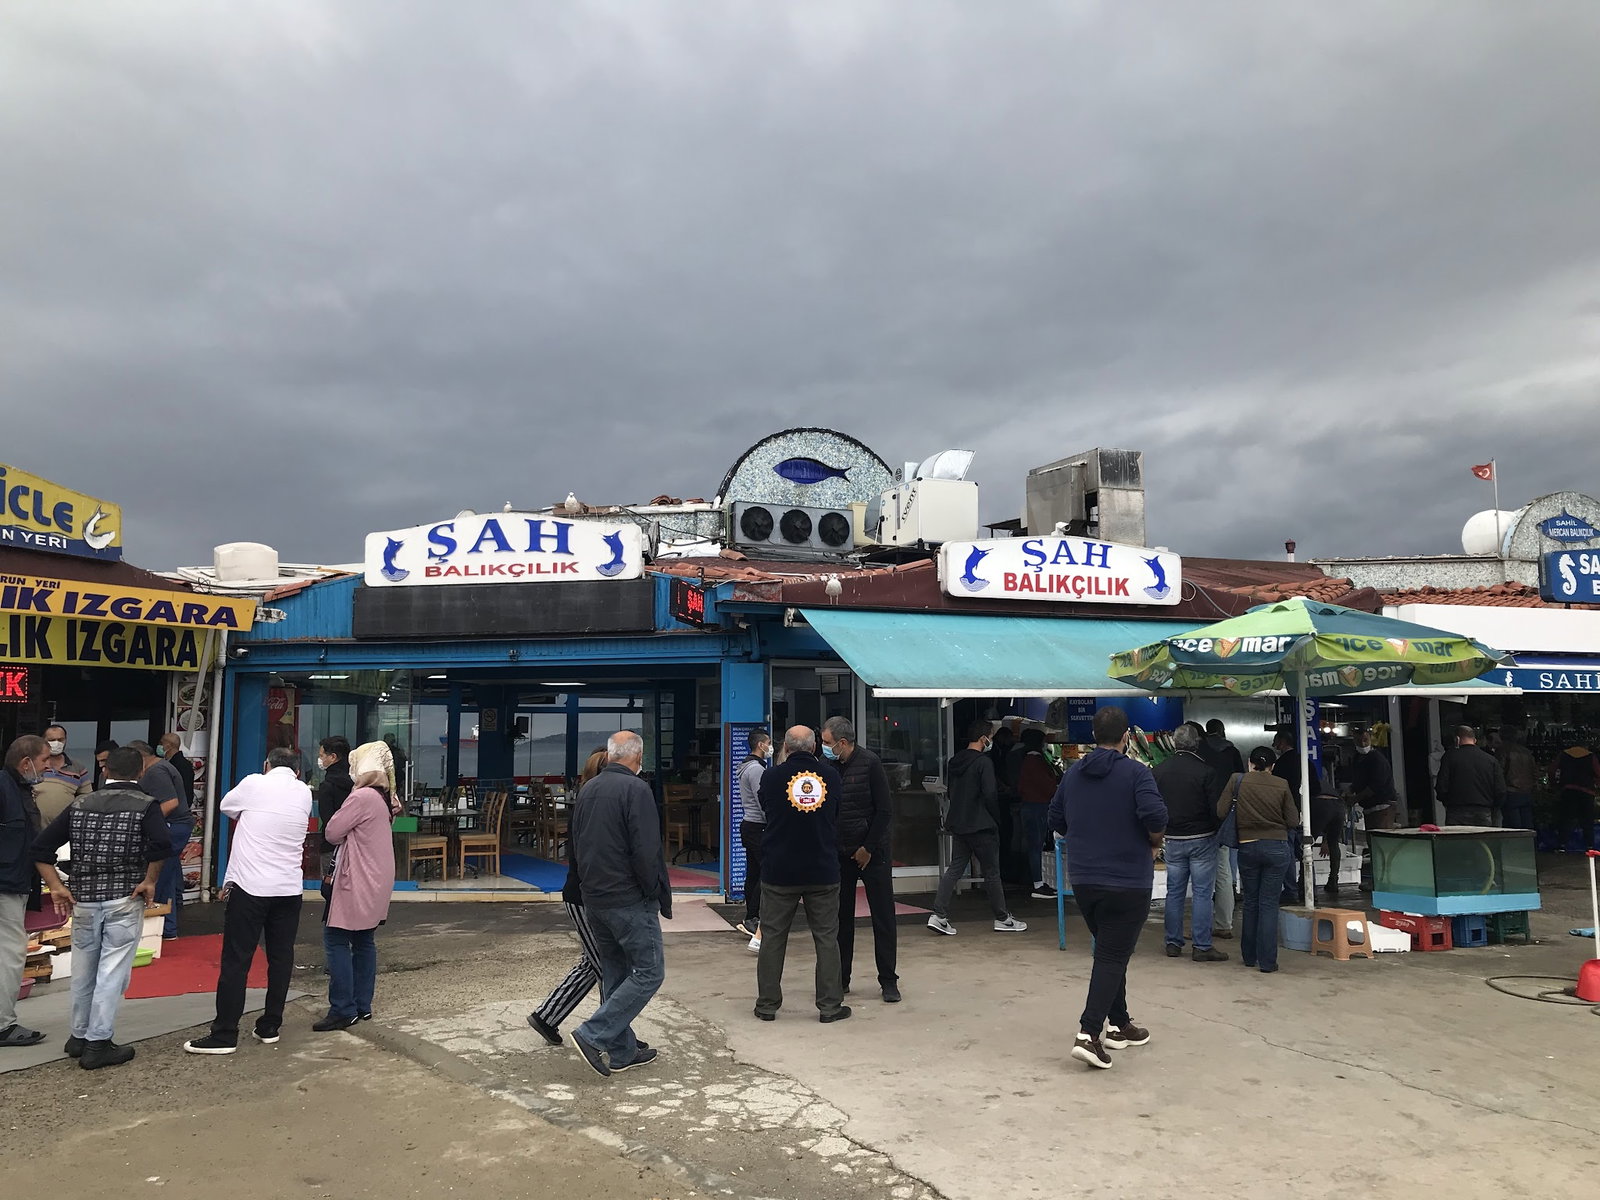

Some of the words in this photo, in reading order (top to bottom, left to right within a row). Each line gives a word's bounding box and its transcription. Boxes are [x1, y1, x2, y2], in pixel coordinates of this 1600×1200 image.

[20, 531, 67, 549] YERİ
[427, 518, 575, 565] ŞAH
[1021, 539, 1113, 572] ŞAH
[425, 561, 580, 578] BALIKÇILIK
[36, 580, 60, 589] YERİ
[1003, 572, 1130, 599] BALIKÇILIK
[62, 591, 239, 627] IZGARA
[66, 619, 198, 668] IZGARA
[1241, 636, 1291, 653] mar
[1411, 641, 1454, 657] mar
